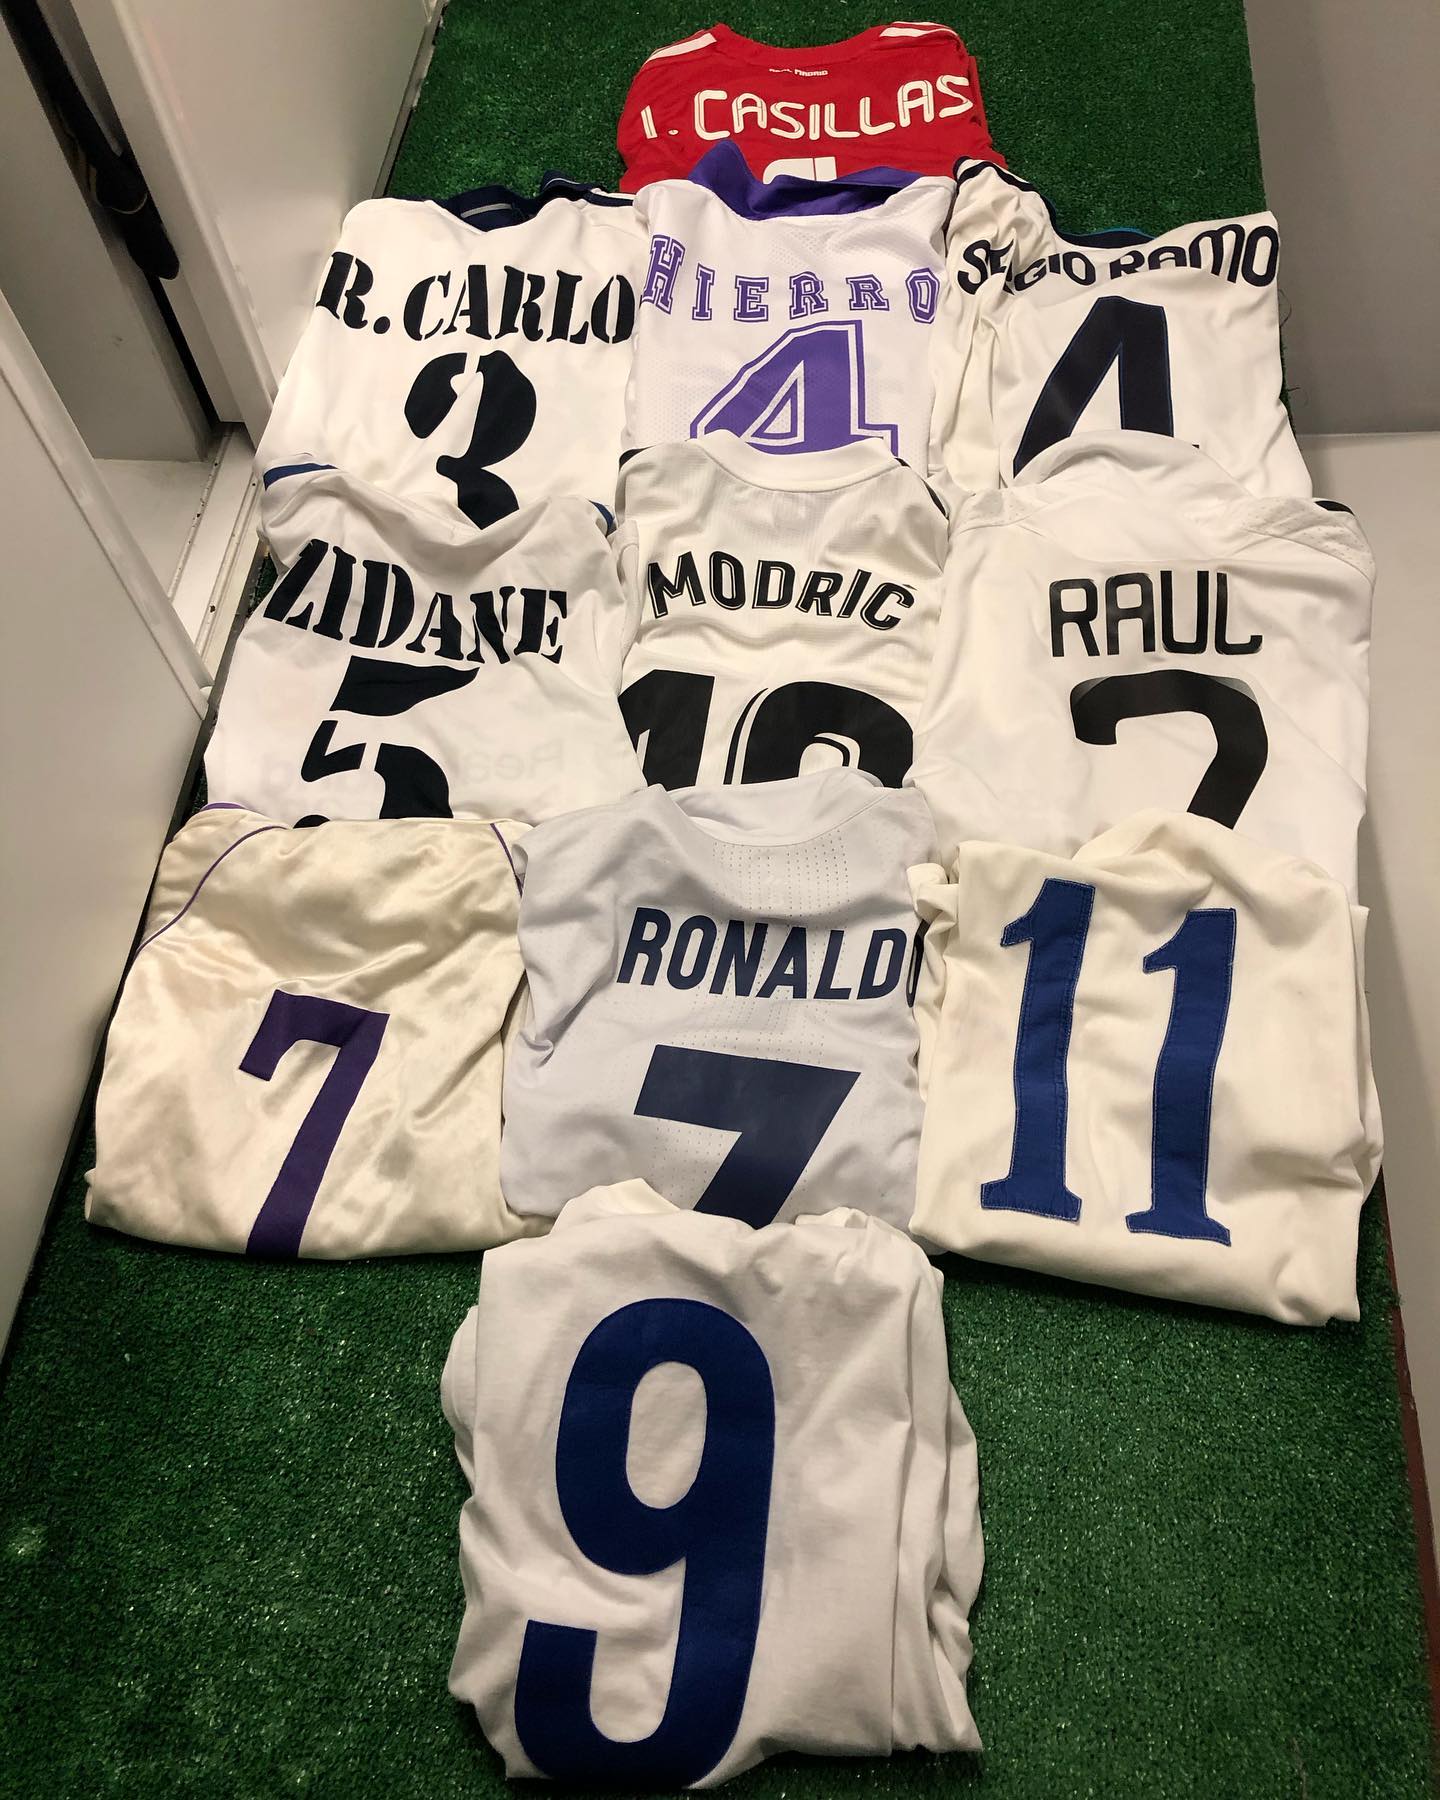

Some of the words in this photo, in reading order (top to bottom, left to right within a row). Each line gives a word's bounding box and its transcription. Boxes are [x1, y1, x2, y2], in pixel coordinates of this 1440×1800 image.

[694, 74, 974, 141] CASILLAS
[640, 234, 941, 325] HIERRO
[404, 349, 537, 530] 3
[690, 319, 899, 458] 4
[263, 538, 568, 665] ZIDANE
[647, 550, 918, 631] MODRIC
[1049, 570, 1263, 657] RAUL
[293, 655, 481, 829] 5
[238, 988, 391, 1259] 7
[633, 1043, 861, 1231] 7
[980, 877, 1237, 1247] 11
[513, 1297, 776, 1789] 9
